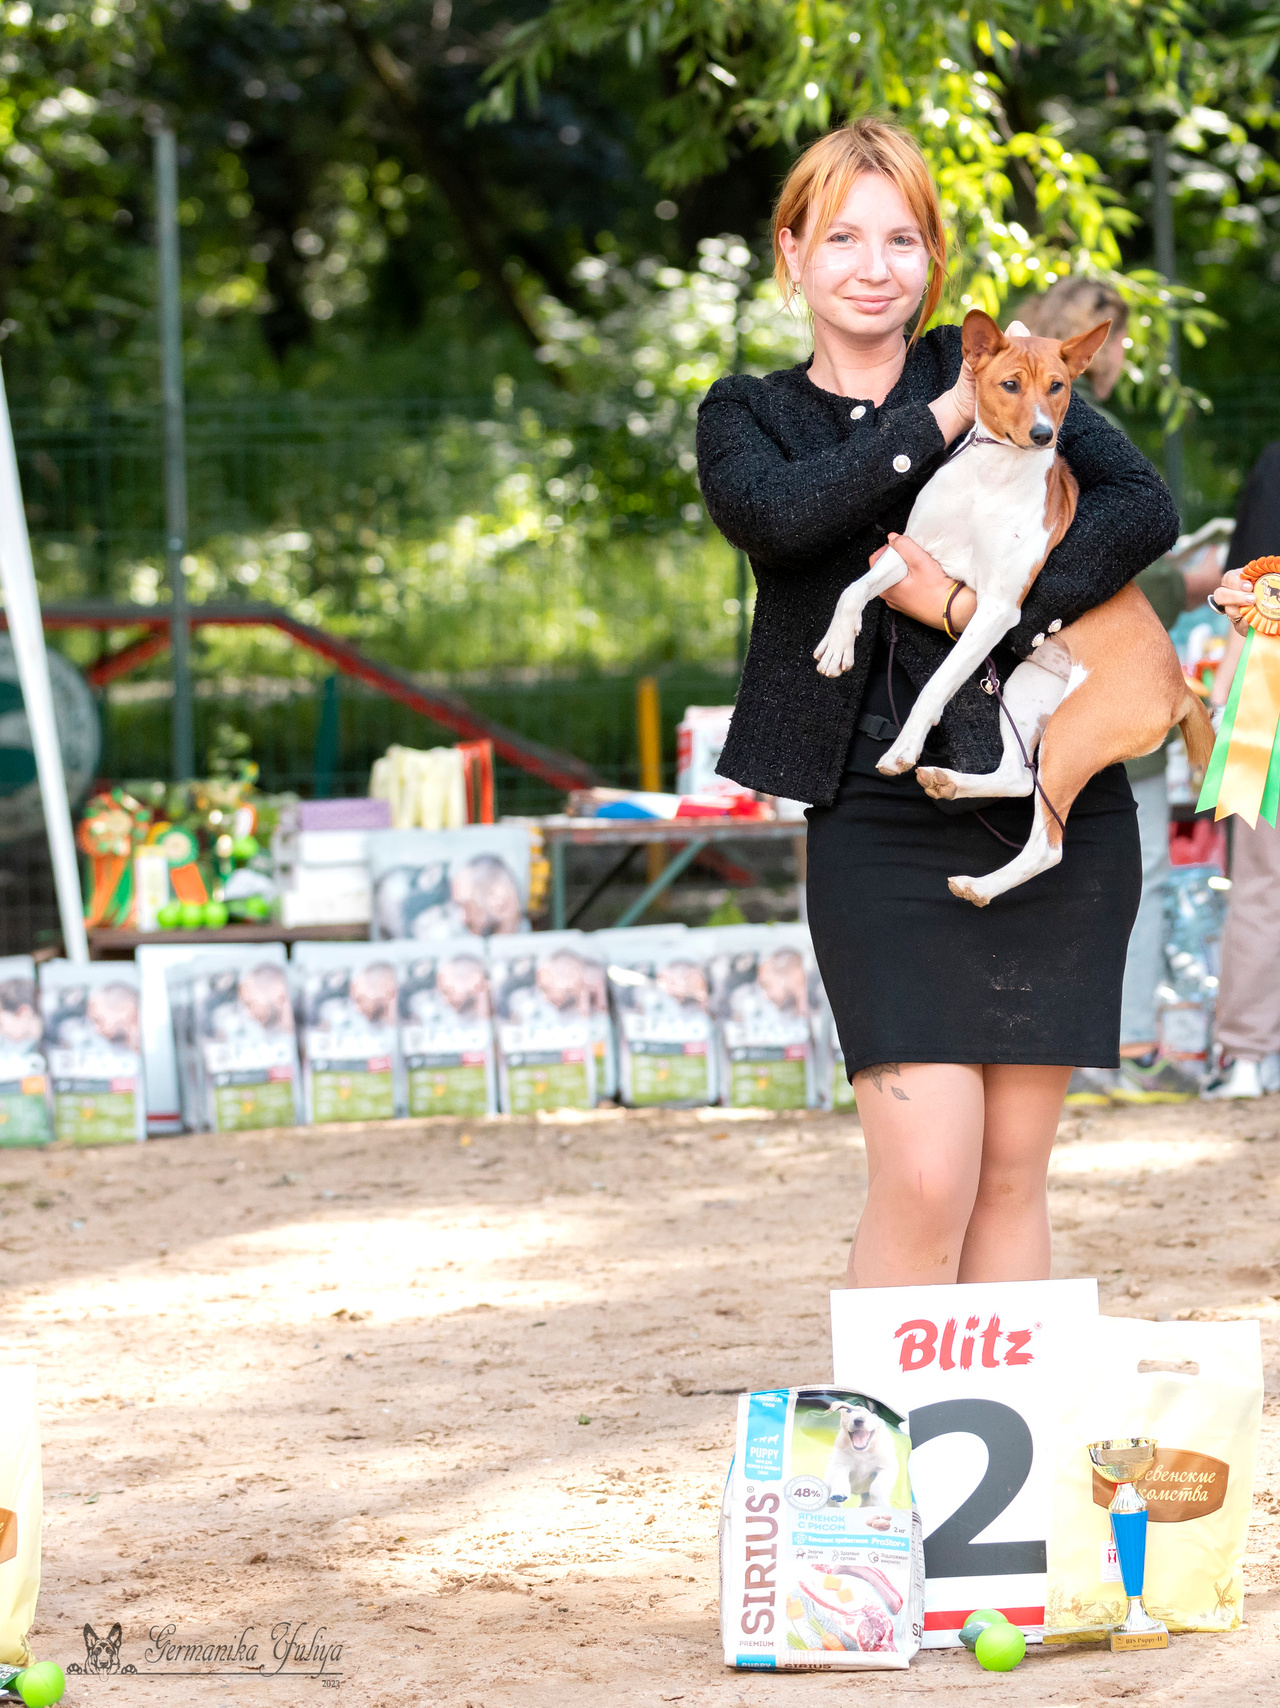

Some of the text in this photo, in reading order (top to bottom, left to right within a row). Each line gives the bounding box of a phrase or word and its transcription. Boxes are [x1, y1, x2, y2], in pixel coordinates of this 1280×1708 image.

[893, 1312, 1035, 1373] Blitz
[750, 1446, 779, 1460] PUPPY
[1144, 1464, 1216, 1483] евенские
[793, 1488, 821, 1497] 48%
[908, 1398, 1047, 1579] 2
[1138, 1485, 1209, 1502] комства
[798, 1512, 846, 1523] ЯГНЕНОК
[797, 1521, 846, 1531] С РИСОМ
[871, 1537, 906, 1548] ProStor+
[740, 1492, 780, 1634] SIRIUS
[739, 1640, 774, 1648] PREMIUM
